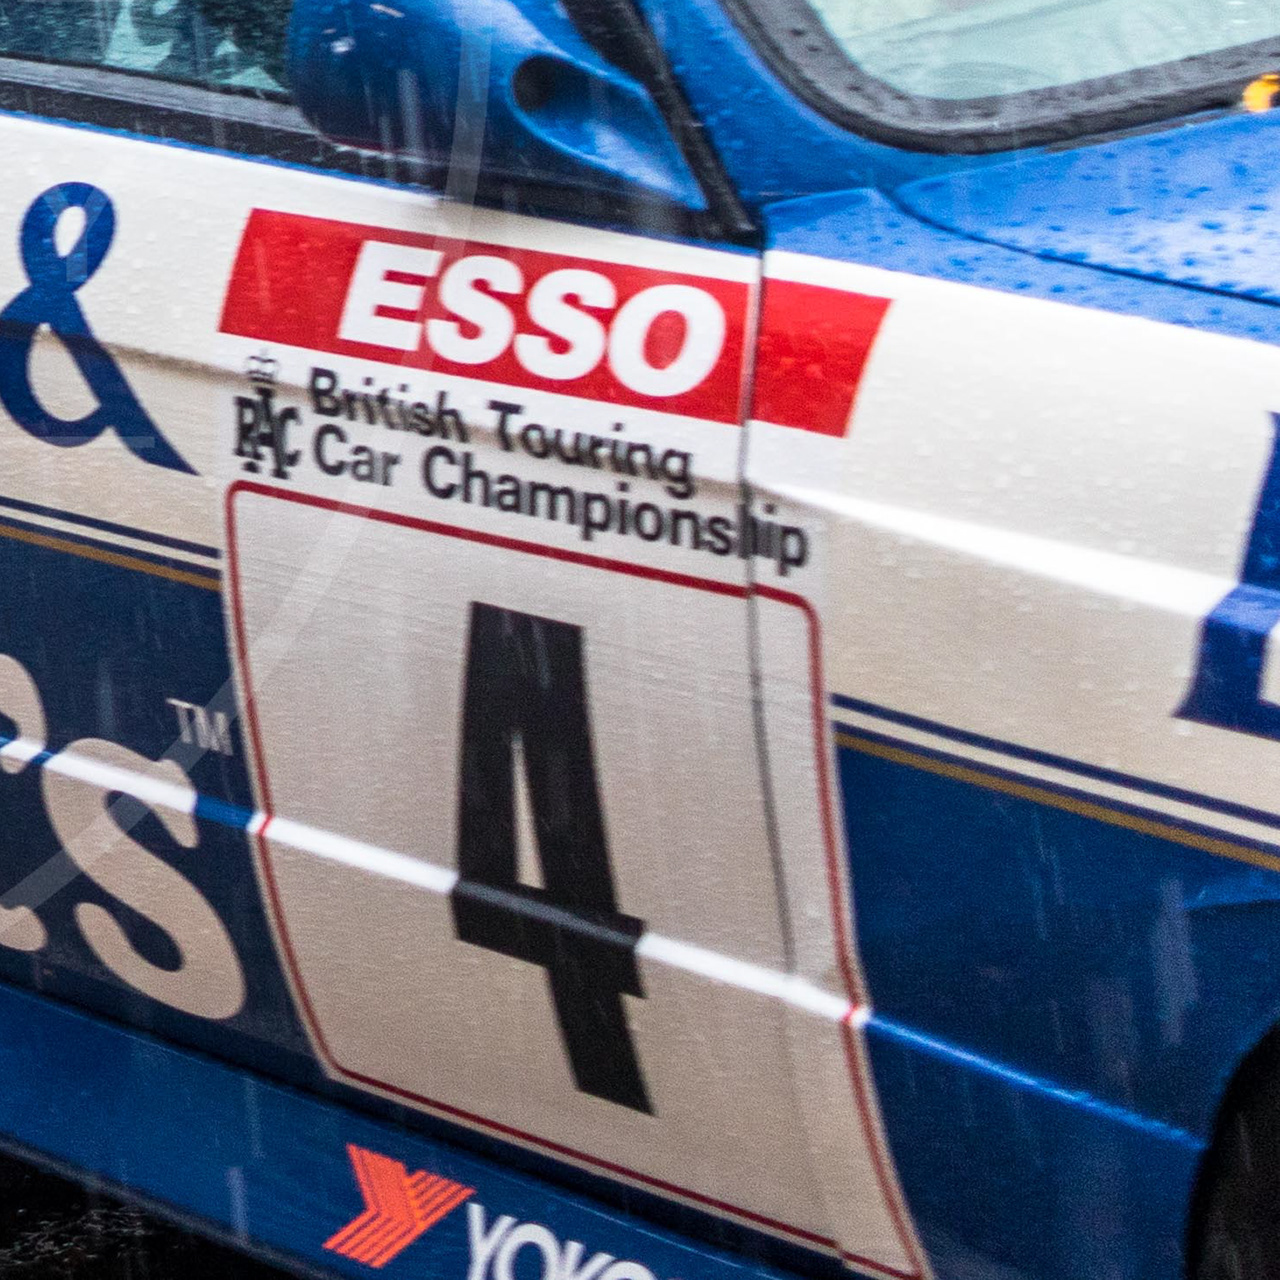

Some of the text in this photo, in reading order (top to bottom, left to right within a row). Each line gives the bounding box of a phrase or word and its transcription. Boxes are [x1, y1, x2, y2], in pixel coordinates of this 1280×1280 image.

[337, 240, 727, 398] ESSO
[310, 366, 694, 499] British Touring
[313, 422, 810, 578] Car Championship
[450, 599, 656, 1118] 4
